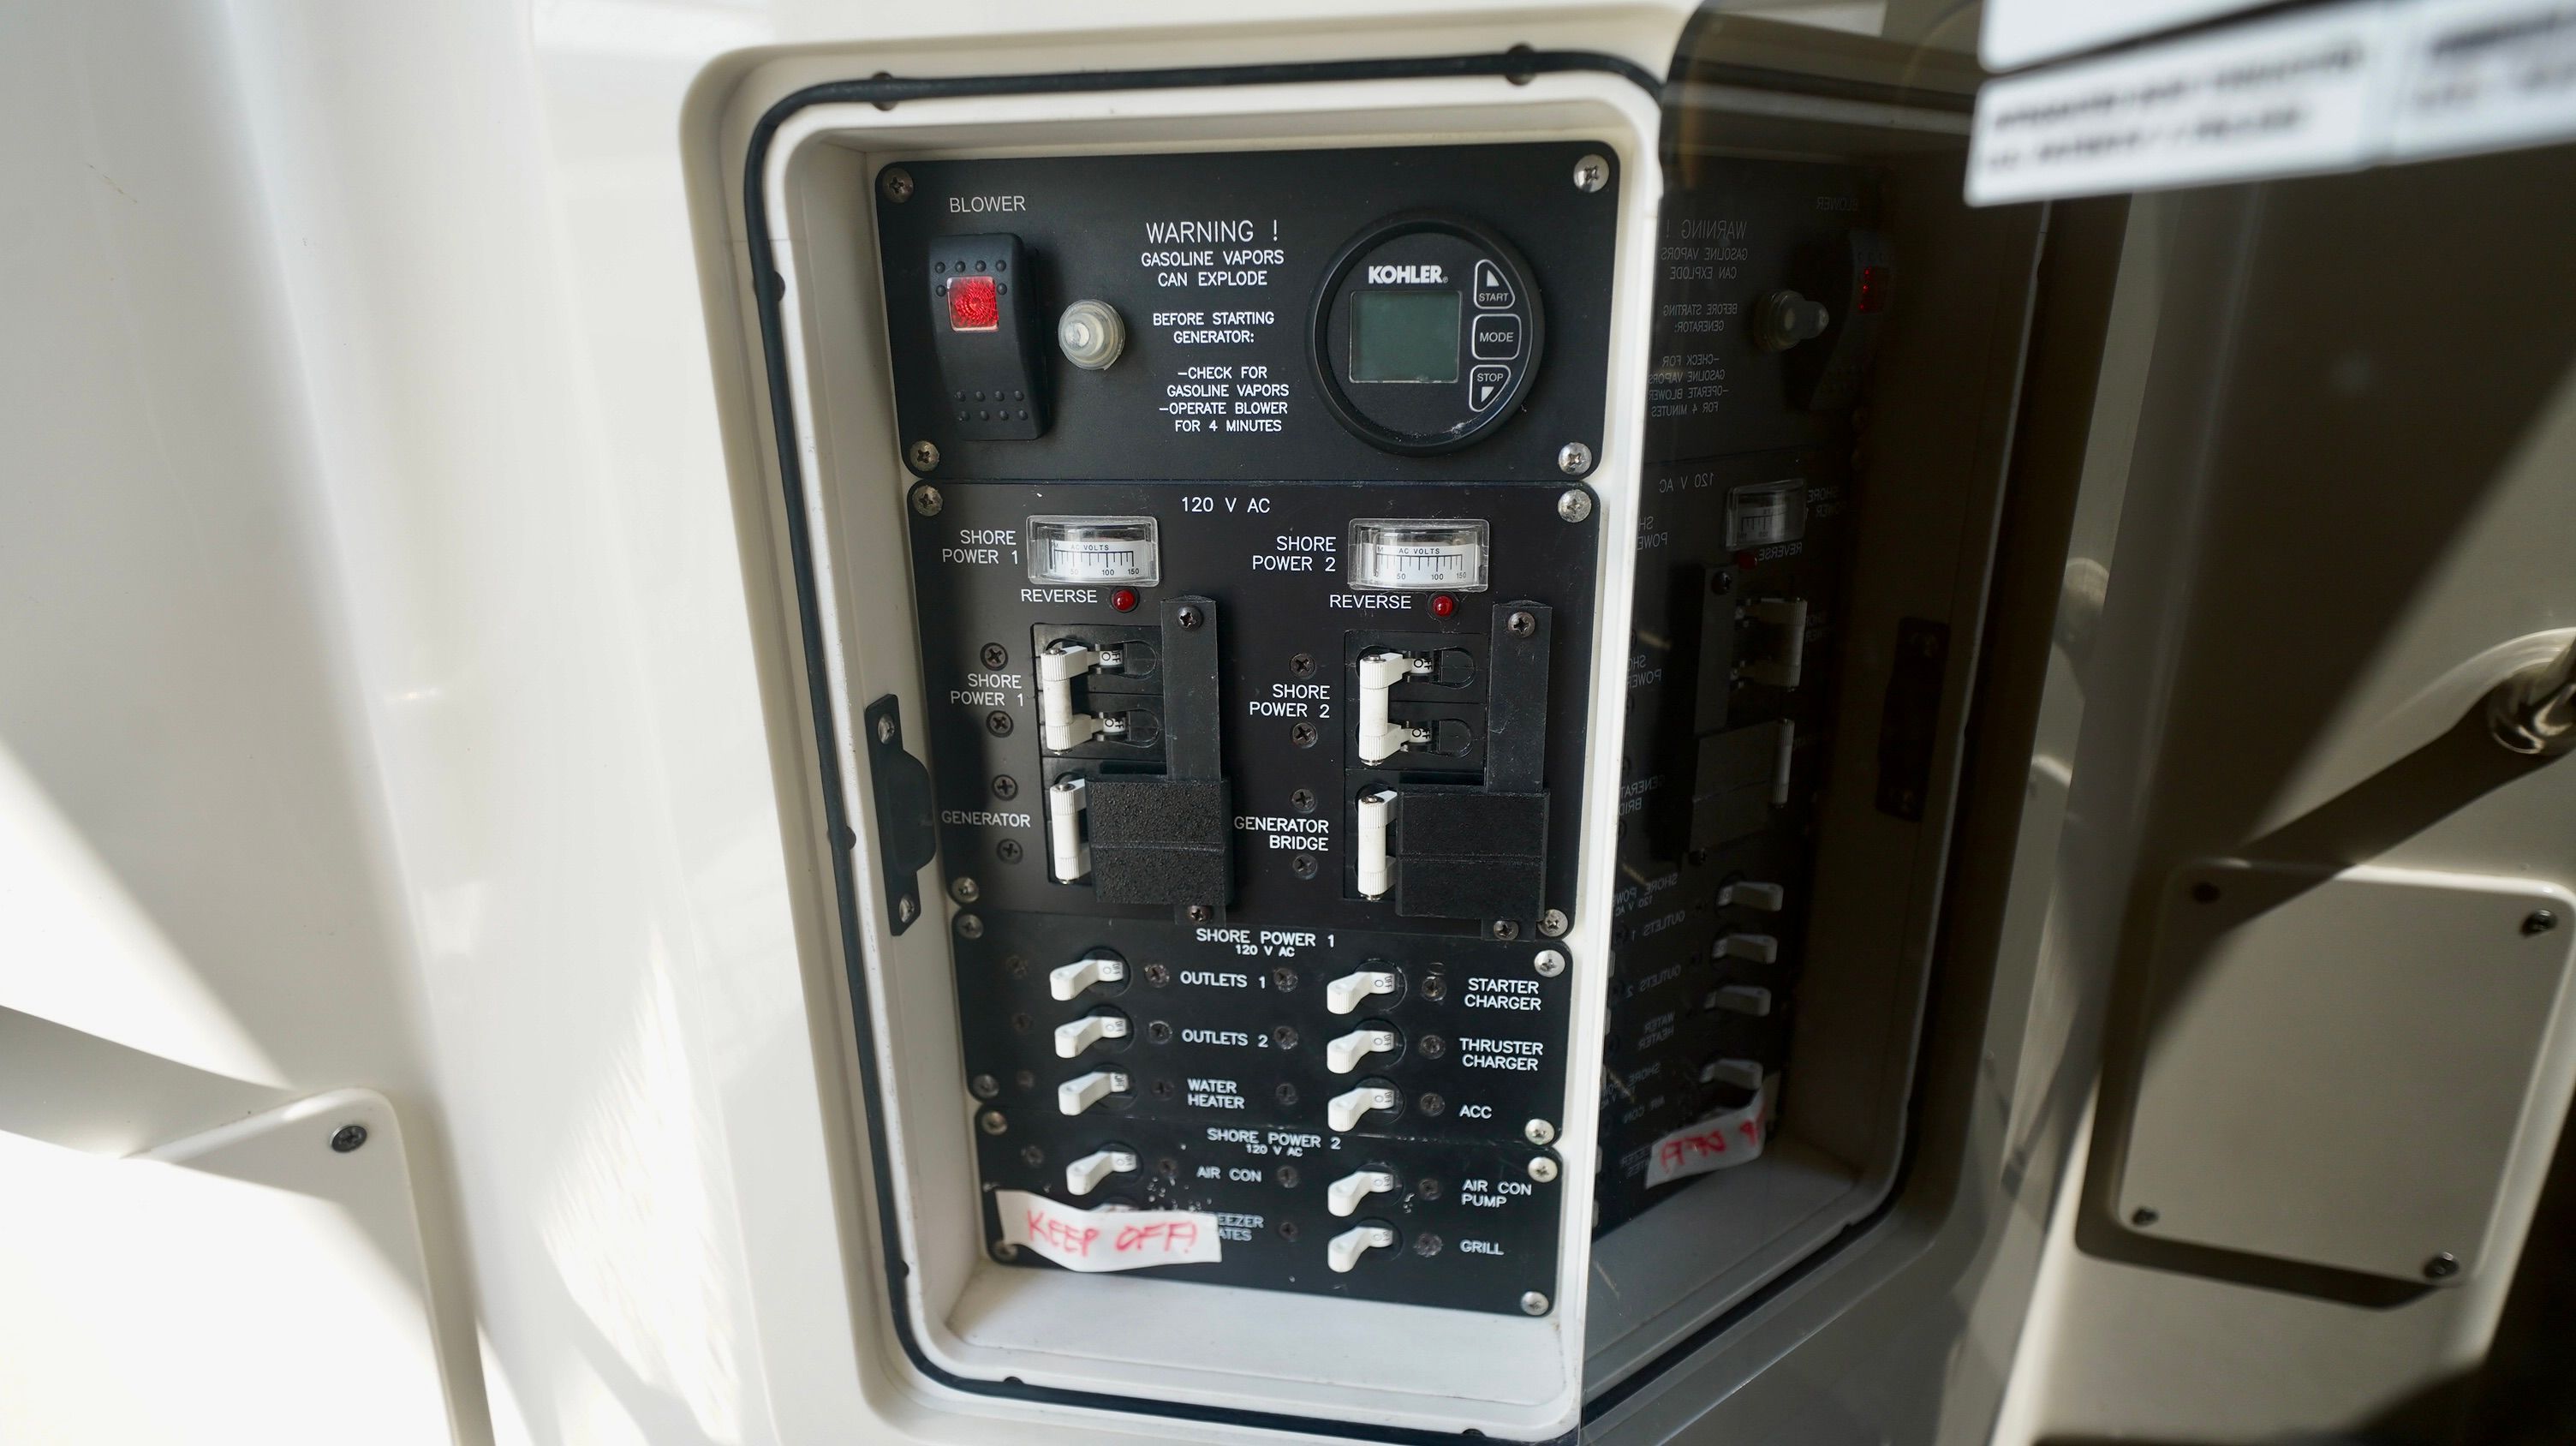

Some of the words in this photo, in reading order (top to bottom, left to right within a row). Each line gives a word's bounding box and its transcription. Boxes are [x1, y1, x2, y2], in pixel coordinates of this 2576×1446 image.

[951, 196, 1025, 212] BLOWER
[1147, 220, 1253, 243] WARNING
[1273, 220, 1277, 241] !
[1142, 251, 1213, 266] GASOLINE
[1223, 250, 1284, 265] VAPORS
[1158, 272, 1187, 286] CAN
[1199, 271, 1267, 286] EXPLODE
[1154, 313, 1204, 326] BEFORE
[1213, 312, 1274, 325] STARTING
[1174, 331, 1254, 344] GENERATOR:
[1480, 332, 1513, 342] MODE
[1242, 367, 1267, 379] FOR
[1167, 385, 1229, 397] GASOLINE
[1237, 384, 1289, 397] VAPORS
[1235, 402, 1287, 414] BLOWER
[1176, 420, 1200, 432] FOR
[1209, 420, 1218, 431] 4
[1226, 420, 1281, 432] MINUTES
[1183, 497, 1213, 511] 120
[1225, 498, 1237, 512] V
[1248, 498, 1270, 513] AC
[961, 530, 1016, 545] SHORE
[1277, 536, 1336, 552] SHORE
[943, 549, 999, 564] POWER
[1012, 550, 1017, 565] 1
[1253, 555, 1312, 571] POWER
[1326, 557, 1335, 571] 2
[1022, 589, 1097, 602] REVERSE
[1330, 595, 1411, 608] REVERSE
[969, 674, 1022, 689] SHORE
[951, 691, 1005, 706] POWER
[1017, 693, 1023, 706] 1
[1273, 684, 1330, 699] SHORE
[1250, 702, 1307, 717] POWER
[1320, 704, 1329, 718] 2
[941, 810, 1030, 828] GENERATOR
[1234, 816, 1328, 834] GENERATOR
[1270, 835, 1328, 851] BRIDGE
[1196, 928, 1250, 943] SHORE
[1261, 931, 1315, 946] POWER
[1328, 935, 1333, 947] 1
[1236, 945, 1258, 955] 120
[1264, 946, 1273, 955] V
[1279, 947, 1295, 957] AC
[1180, 971, 1247, 987] OUTLETS
[1259, 977, 1265, 989] 1
[1468, 978, 1539, 995] STARTER
[1464, 995, 1541, 1011] CHARGER
[1182, 1030, 1248, 1046] OUTLETS
[1258, 1035, 1268, 1048] 2
[1460, 1038, 1543, 1055] THRUSTER
[1463, 1055, 1538, 1071] CHARGER
[1188, 1079, 1237, 1093] WATER
[1188, 1094, 1244, 1108] HEATER
[1460, 1105, 1492, 1119] ACC
[1208, 1128, 1259, 1144] SHORE
[1268, 1132, 1321, 1147] POWER
[1331, 1137, 1340, 1150] 2
[1247, 1144, 1267, 1154] 120
[1273, 1146, 1282, 1155] V
[1287, 1147, 1303, 1156] AC
[1197, 1167, 1220, 1179] AIR
[1229, 1168, 1261, 1182] CON
[1463, 1180, 1488, 1193] AIR
[1498, 1182, 1531, 1195] CON
[1462, 1193, 1506, 1207] PUMP
[1219, 1213, 1264, 1228] EEZER
[1028, 1210, 1099, 1257] KEEP
[1219, 1227, 1252, 1242] ATES
[1460, 1240, 1504, 1255] GRILL
